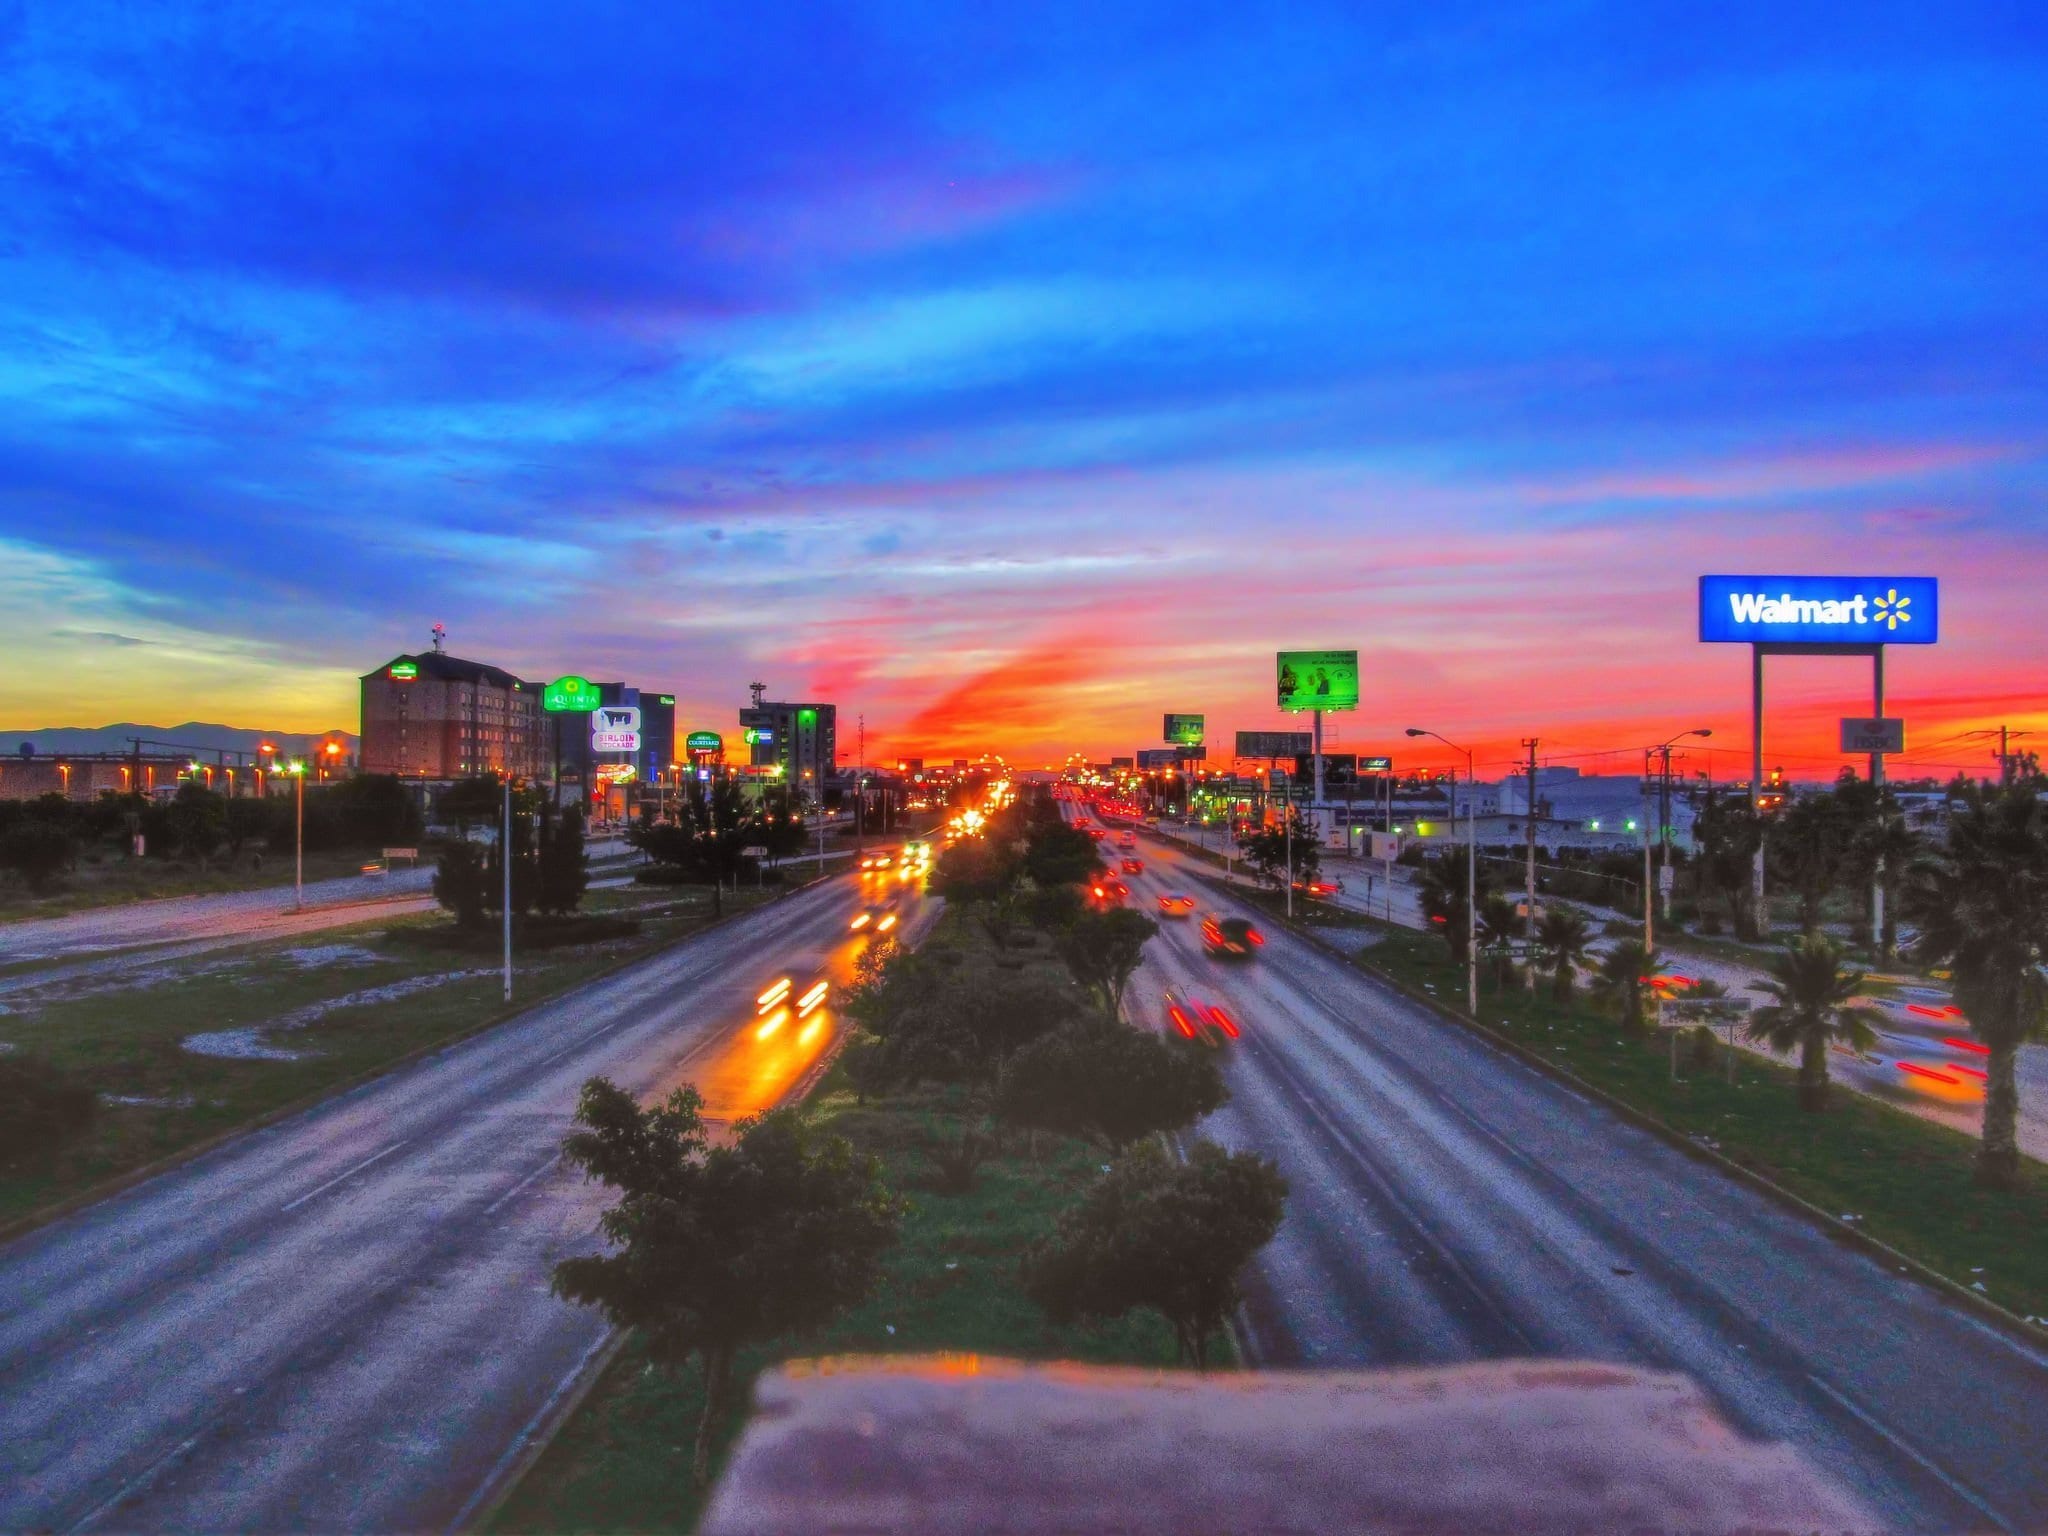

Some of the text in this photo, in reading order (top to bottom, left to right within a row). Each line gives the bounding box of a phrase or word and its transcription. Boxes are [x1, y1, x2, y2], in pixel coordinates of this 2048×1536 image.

[1729, 593, 1867, 624] Walmart
[554, 695, 597, 705] QUINTA
[599, 734, 635, 742] SIRLOIN
